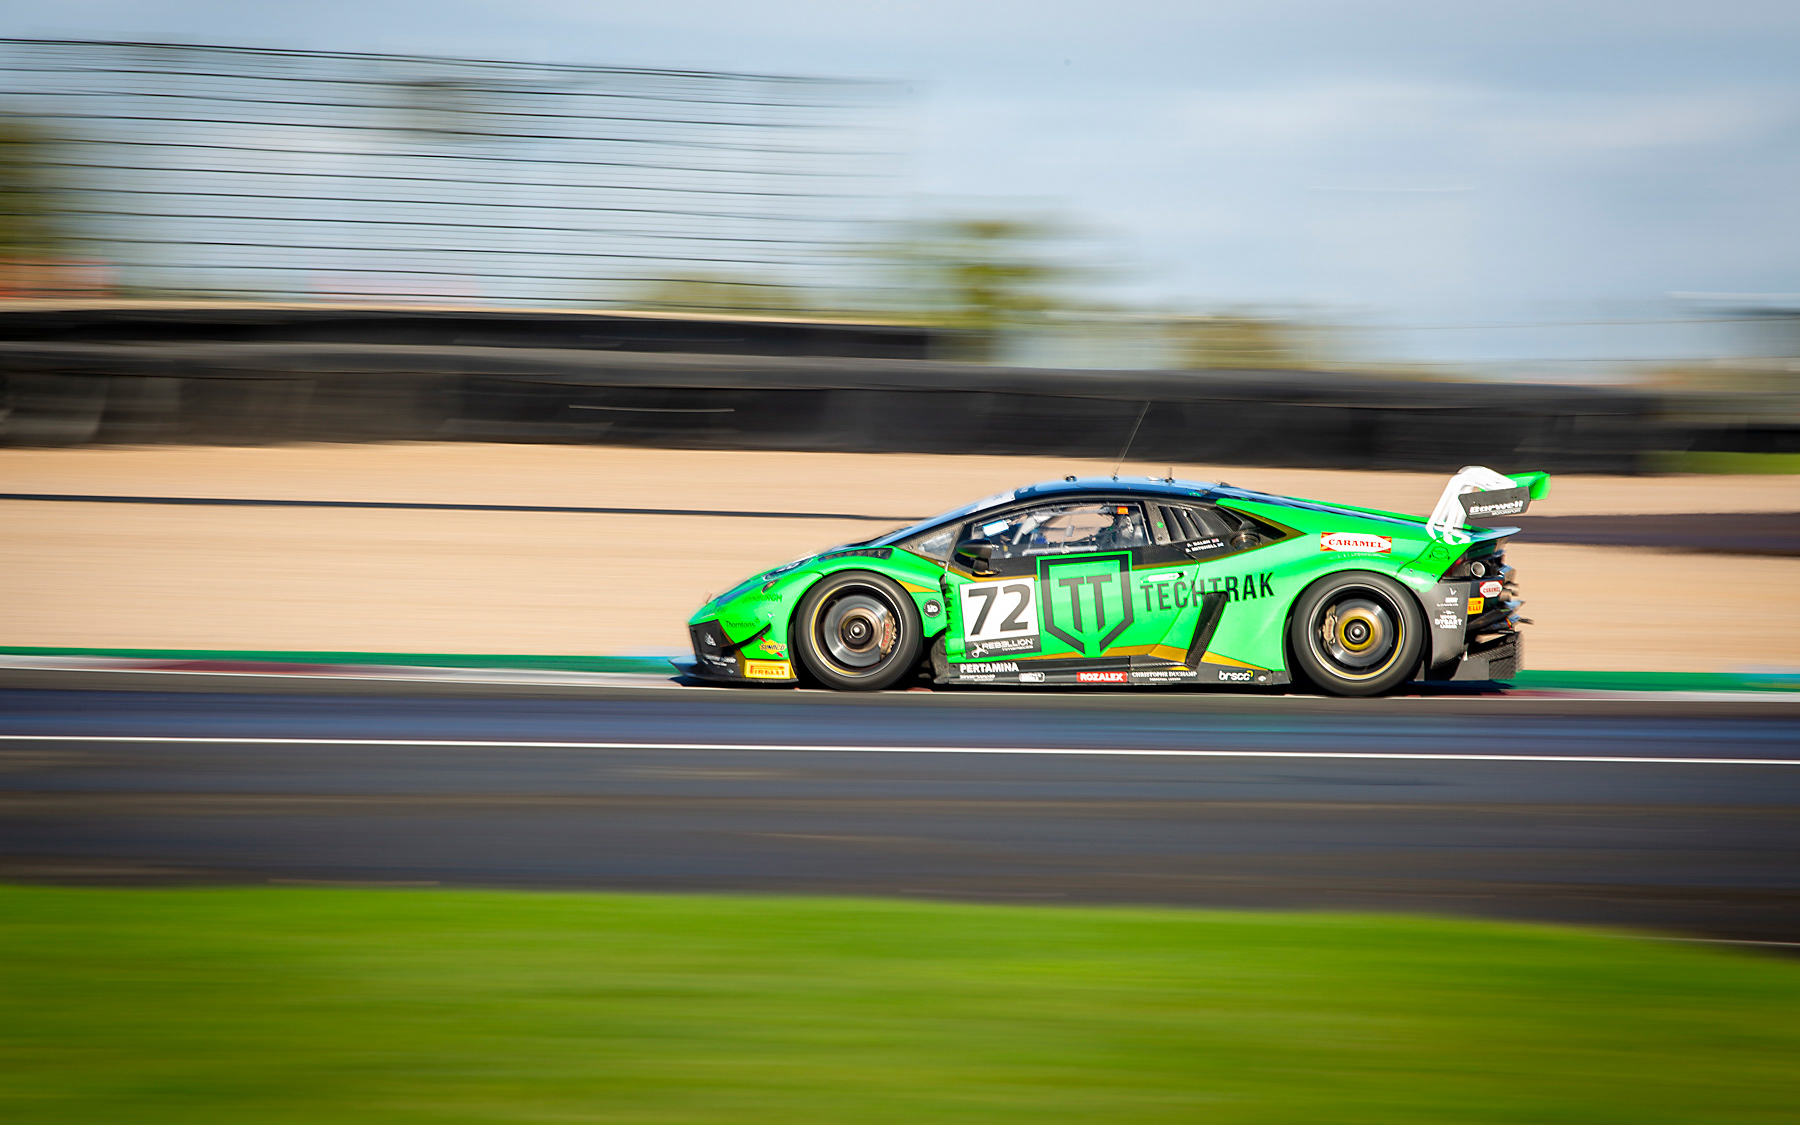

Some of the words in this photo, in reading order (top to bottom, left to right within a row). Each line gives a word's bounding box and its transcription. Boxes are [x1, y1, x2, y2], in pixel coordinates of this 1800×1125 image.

[1470, 500, 1523, 513] Barwell
[1328, 538, 1384, 548] CARAMEL
[1140, 571, 1275, 612] TECHTRAK
[1059, 574, 1112, 633] TT
[968, 583, 1031, 636] 72
[725, 620, 756, 628] Thorntons
[760, 643, 785, 651] SUNOCO
[982, 638, 1034, 650] REBELLION
[750, 665, 785, 675] PIRELLI
[960, 662, 1019, 673] PERTAMINA
[1079, 673, 1123, 682] ROZALEX
[1218, 669, 1251, 681] brscc
